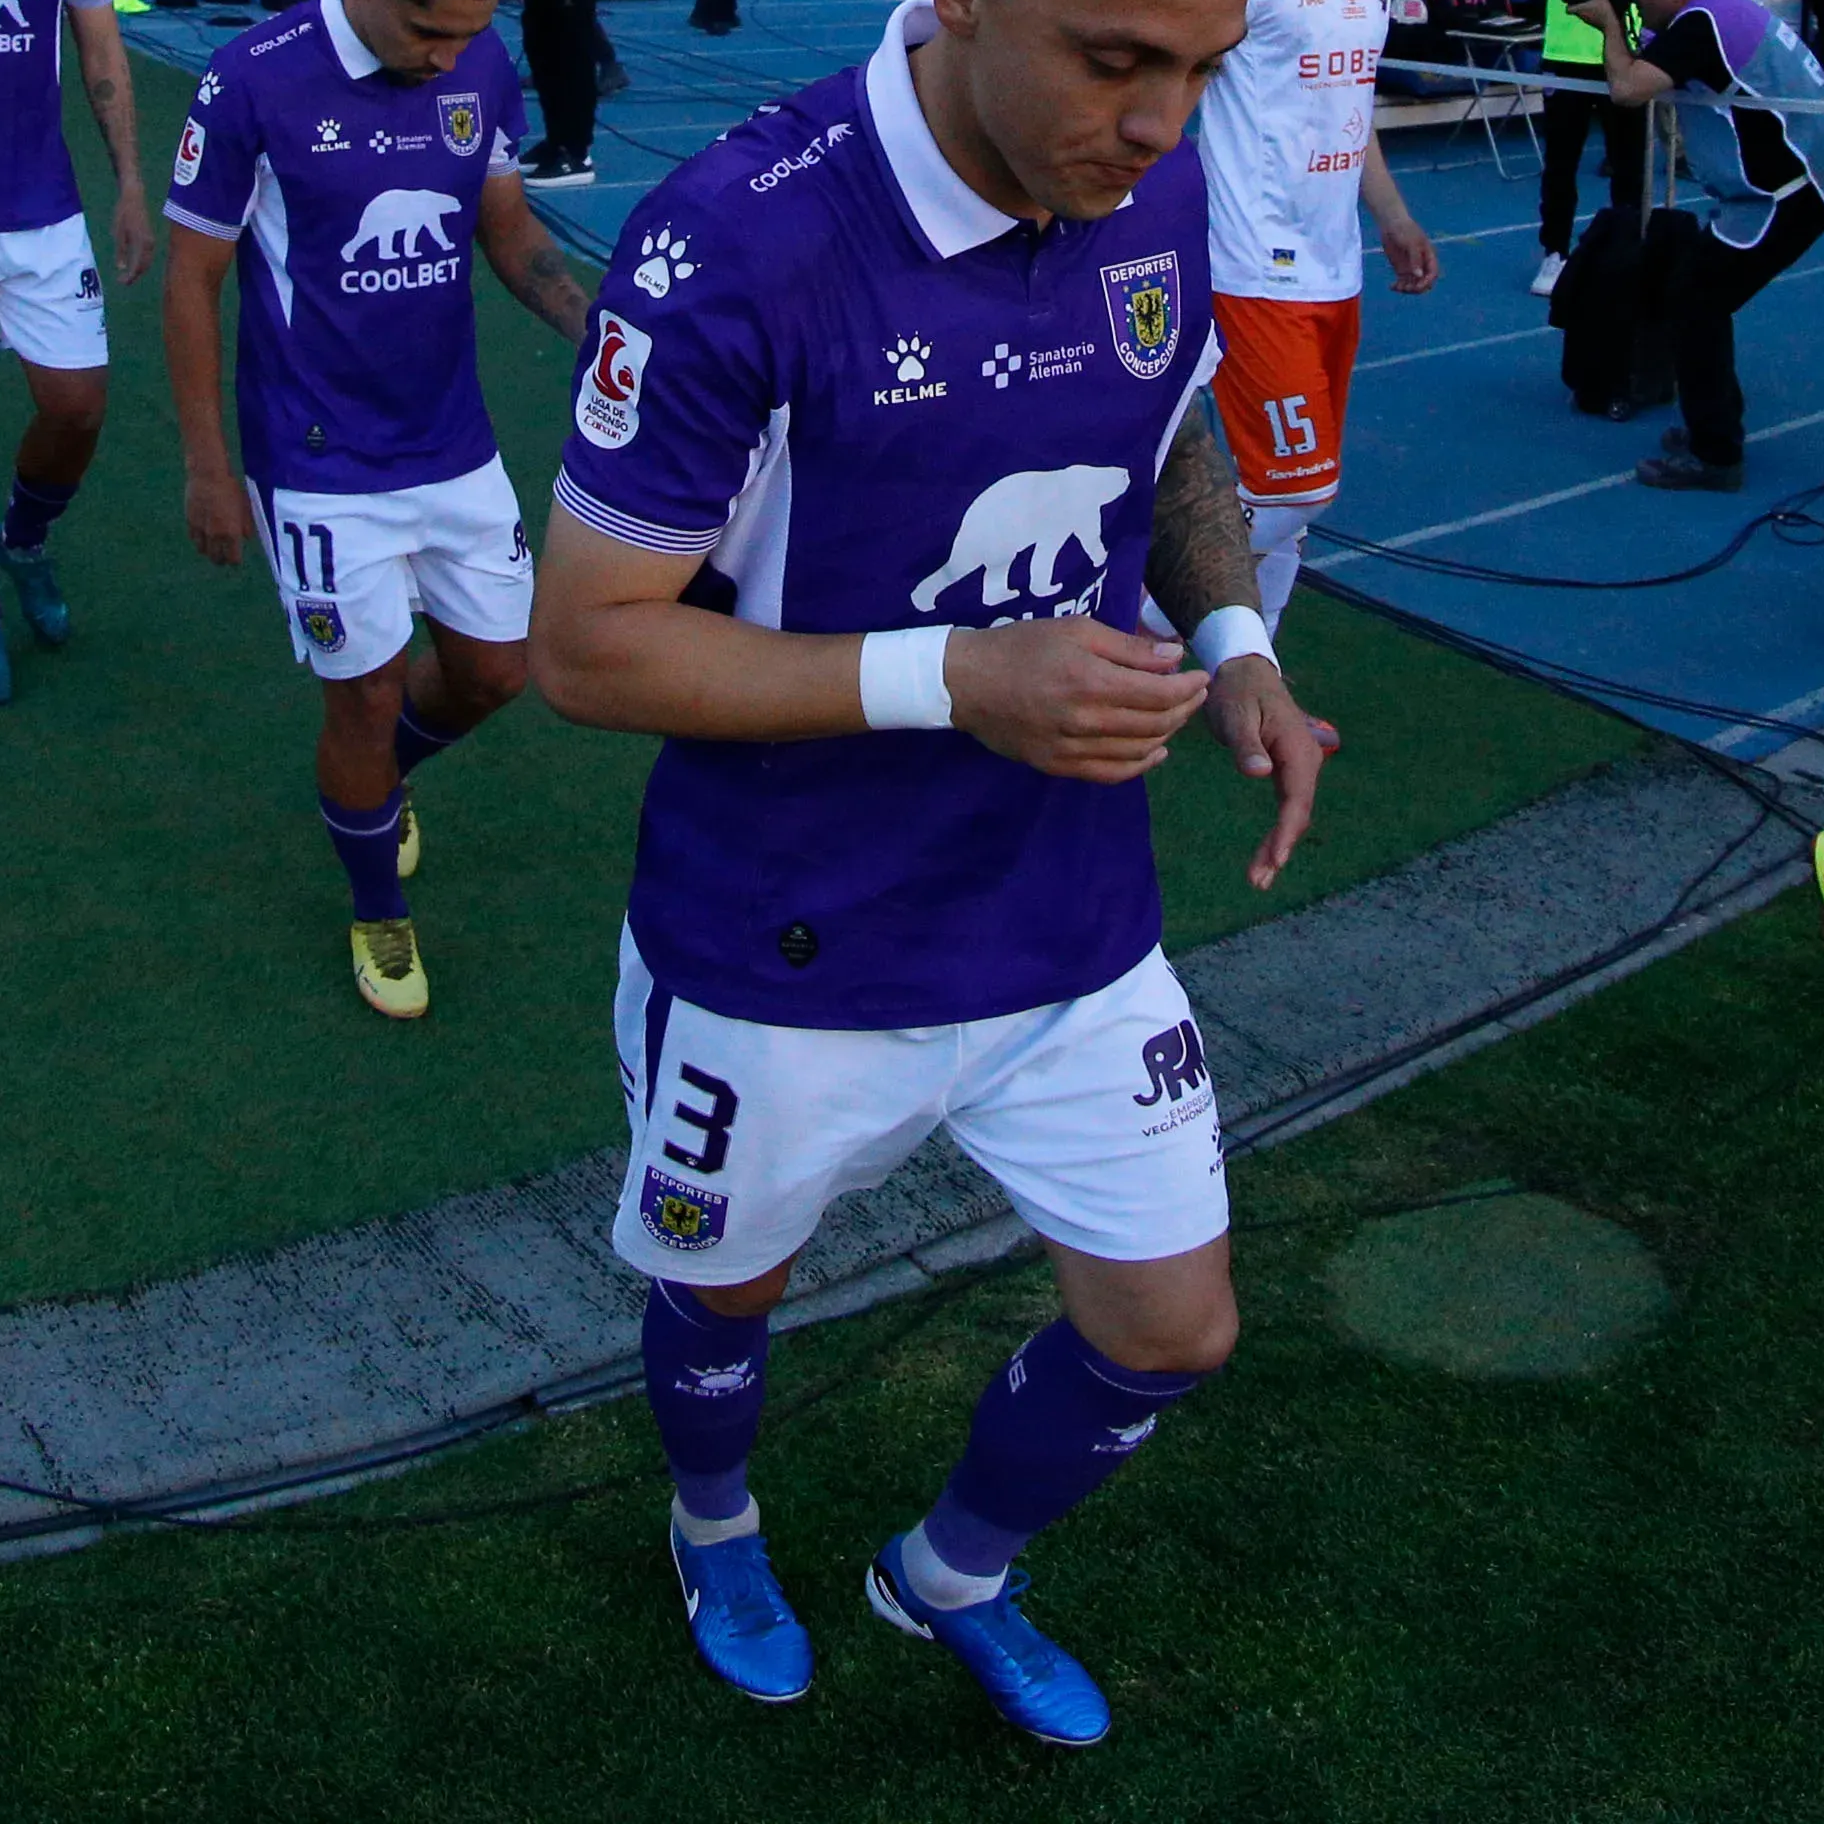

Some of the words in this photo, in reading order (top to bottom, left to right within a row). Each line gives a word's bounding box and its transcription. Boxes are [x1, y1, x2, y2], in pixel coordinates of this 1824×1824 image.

[249, 28, 299, 57] COOLBET
[441, 95, 476, 106] DEPORTES
[311, 140, 351, 153] KELME
[340, 257, 461, 293] COOLBET
[638, 270, 667, 294] KELME
[1109, 256, 1174, 284] DEPORTES
[1028, 341, 1096, 365] Sanatorio
[1028, 358, 1082, 382] Alemán
[591, 393, 612, 413] LIGA
[612, 406, 626, 420] DE
[873, 381, 948, 406] KELME
[584, 403, 629, 432] ASCENSO
[1263, 393, 1318, 458] 15
[283, 521, 336, 594] 11
[662, 1060, 740, 1175] 3
[1142, 1119, 1178, 1138] VEGA
[651, 1169, 723, 1205] DEPORTES
